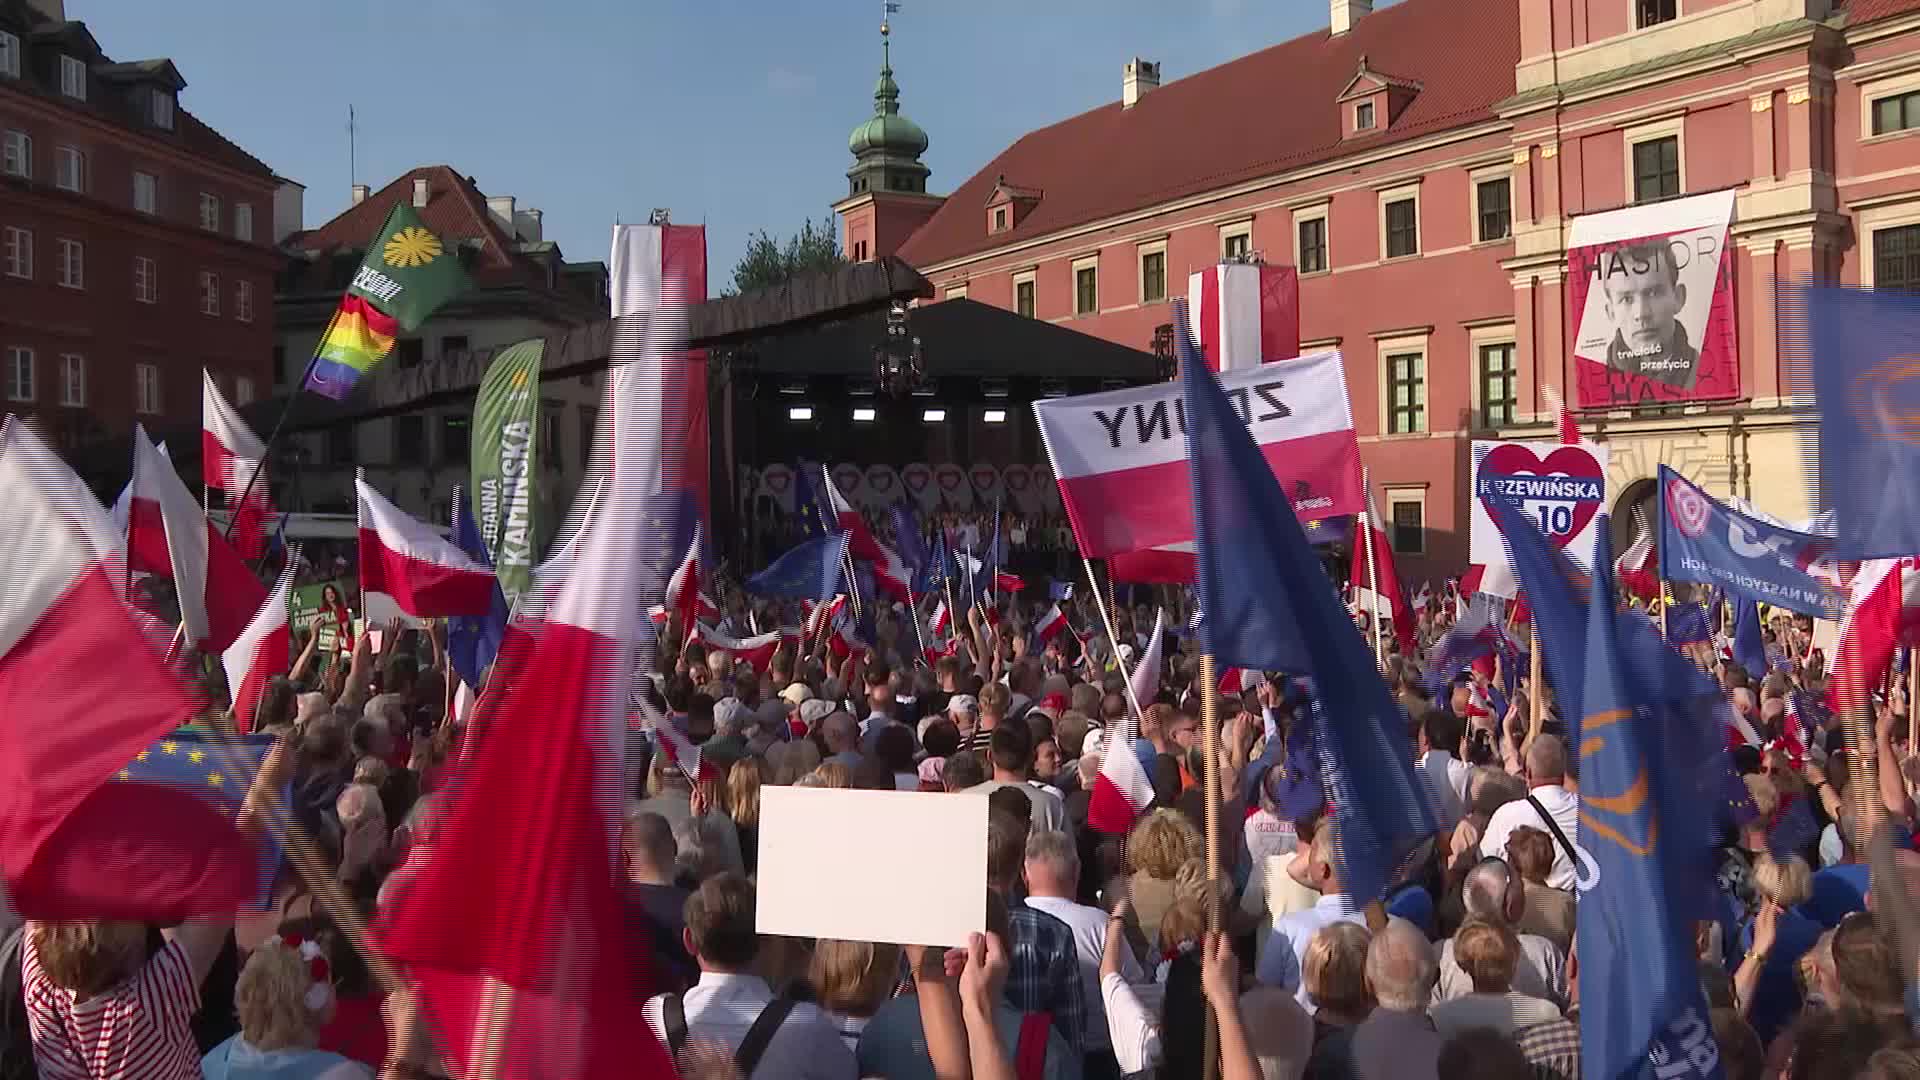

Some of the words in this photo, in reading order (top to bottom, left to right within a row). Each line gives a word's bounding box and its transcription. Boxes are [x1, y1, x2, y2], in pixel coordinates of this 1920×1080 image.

[1583, 235, 1718, 281] HASIOR
[1617, 344, 1662, 360] trwałość
[1640, 357, 1691, 372] przeżycia
[499, 418, 530, 567] KAMIŃSKA
[481, 479, 498, 545] JOANNA
[1538, 505, 1572, 533] 10
